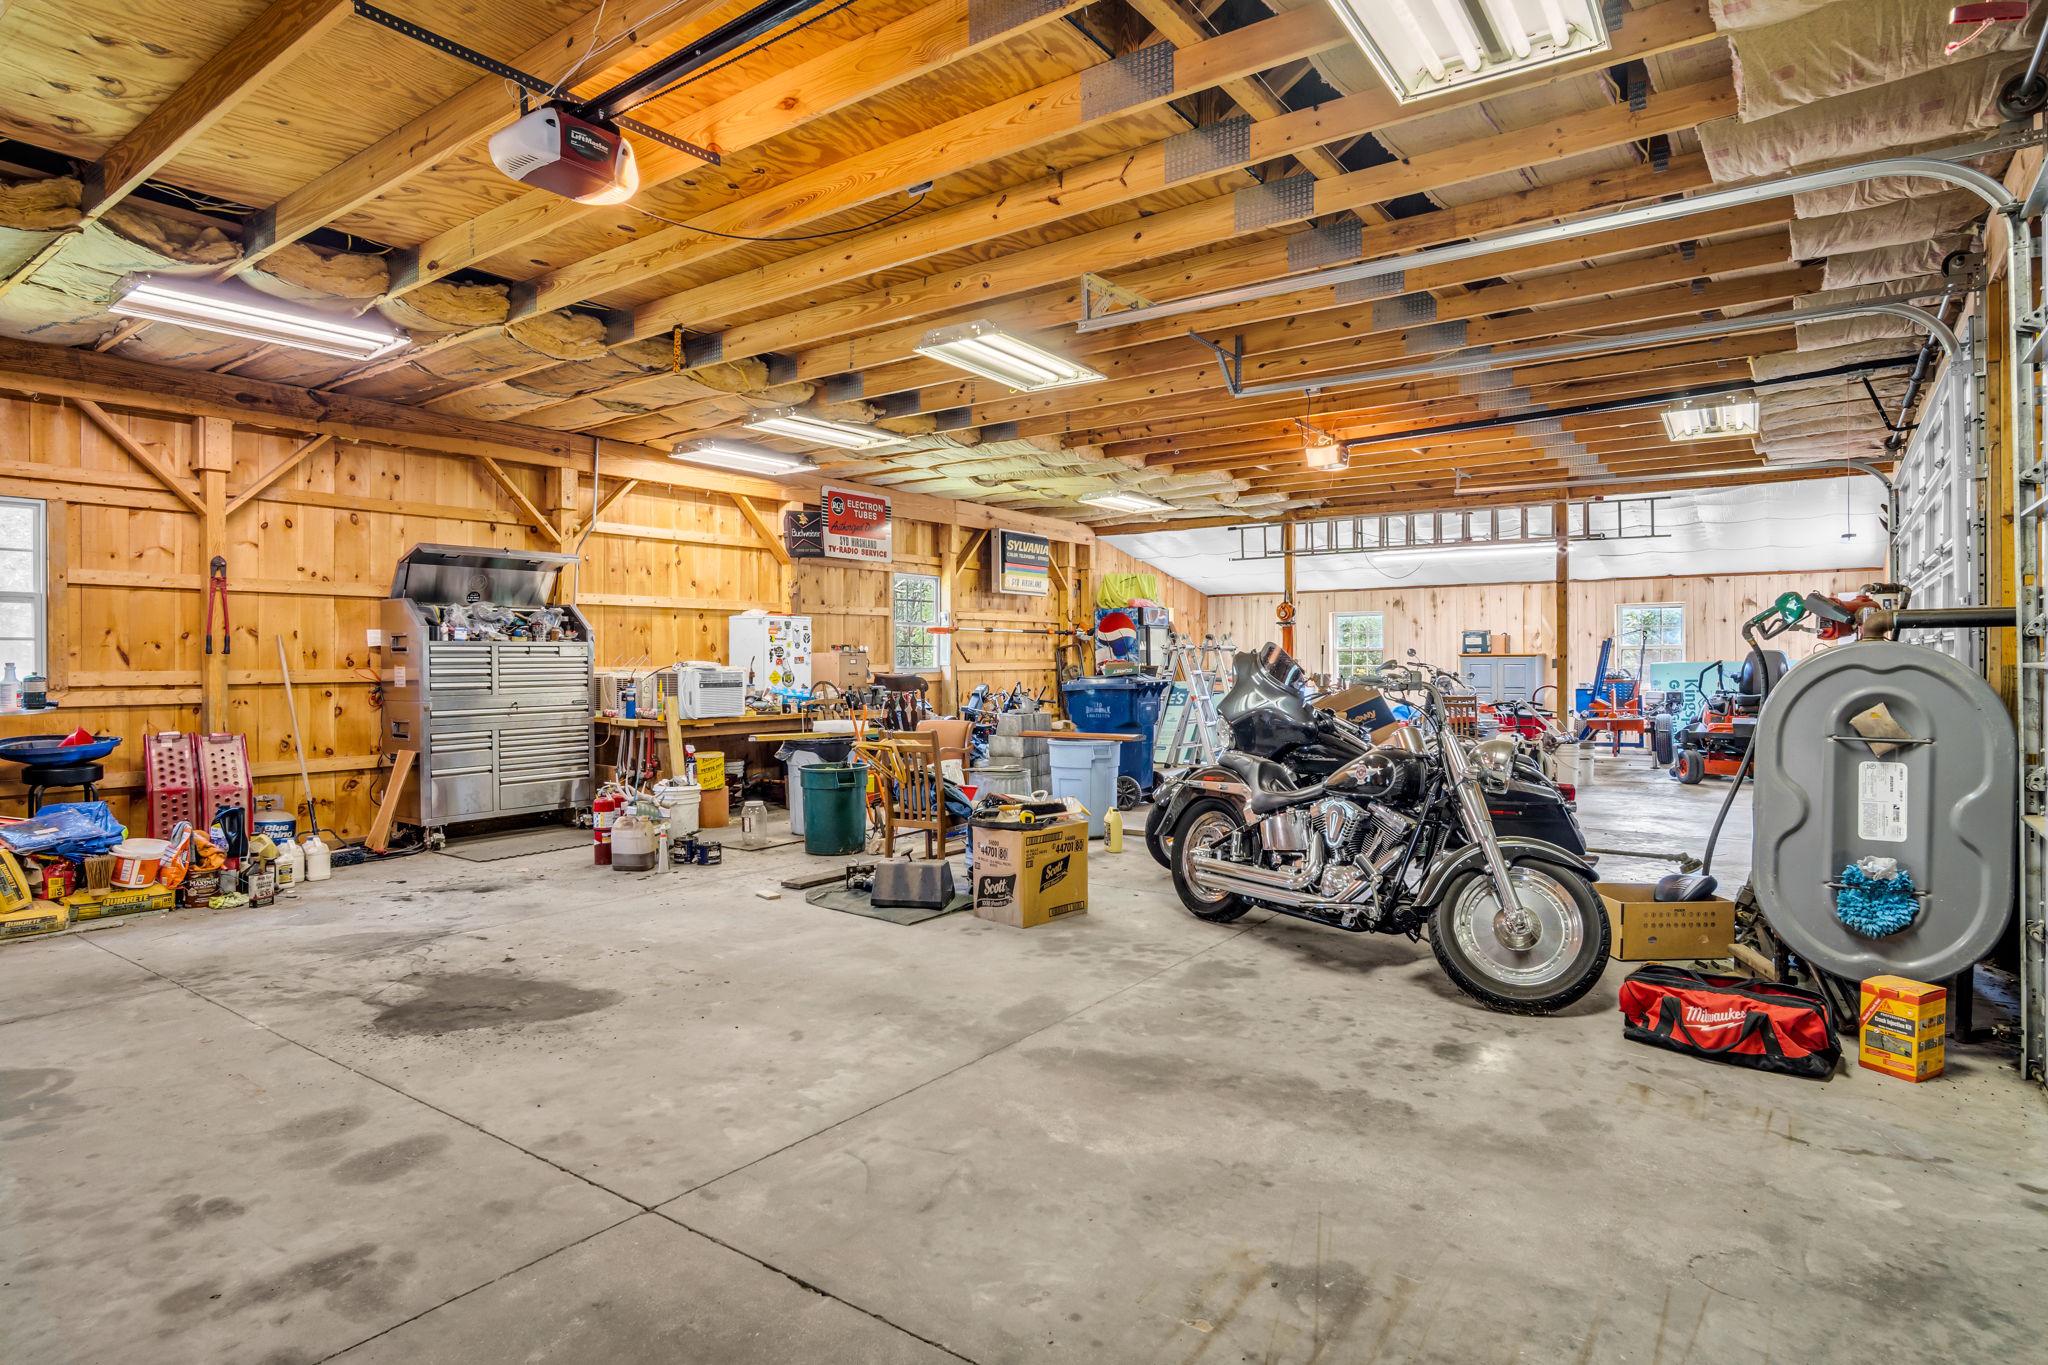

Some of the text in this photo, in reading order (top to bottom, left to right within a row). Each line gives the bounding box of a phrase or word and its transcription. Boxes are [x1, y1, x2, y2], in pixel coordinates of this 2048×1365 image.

[571, 132, 608, 151] LiftMaster
[847, 500, 883, 512] ELECTRON
[854, 510, 877, 520] TUBES
[792, 528, 820, 538] Budweiser
[861, 549, 887, 558] SERVICE
[1007, 540, 1049, 556] SYLVANIA
[264, 824, 289, 832] Blue
[981, 845, 998, 858] 44701
[1056, 842, 1074, 854] 44701
[1046, 861, 1064, 879] Scott
[984, 878, 1008, 895] Scott
[103, 894, 150, 906] QUIKRETE
[5, 919, 40, 928] QUIKRETE
[1686, 1005, 1746, 1023] Milwaukee
[1874, 1016, 1886, 1024] Crack
